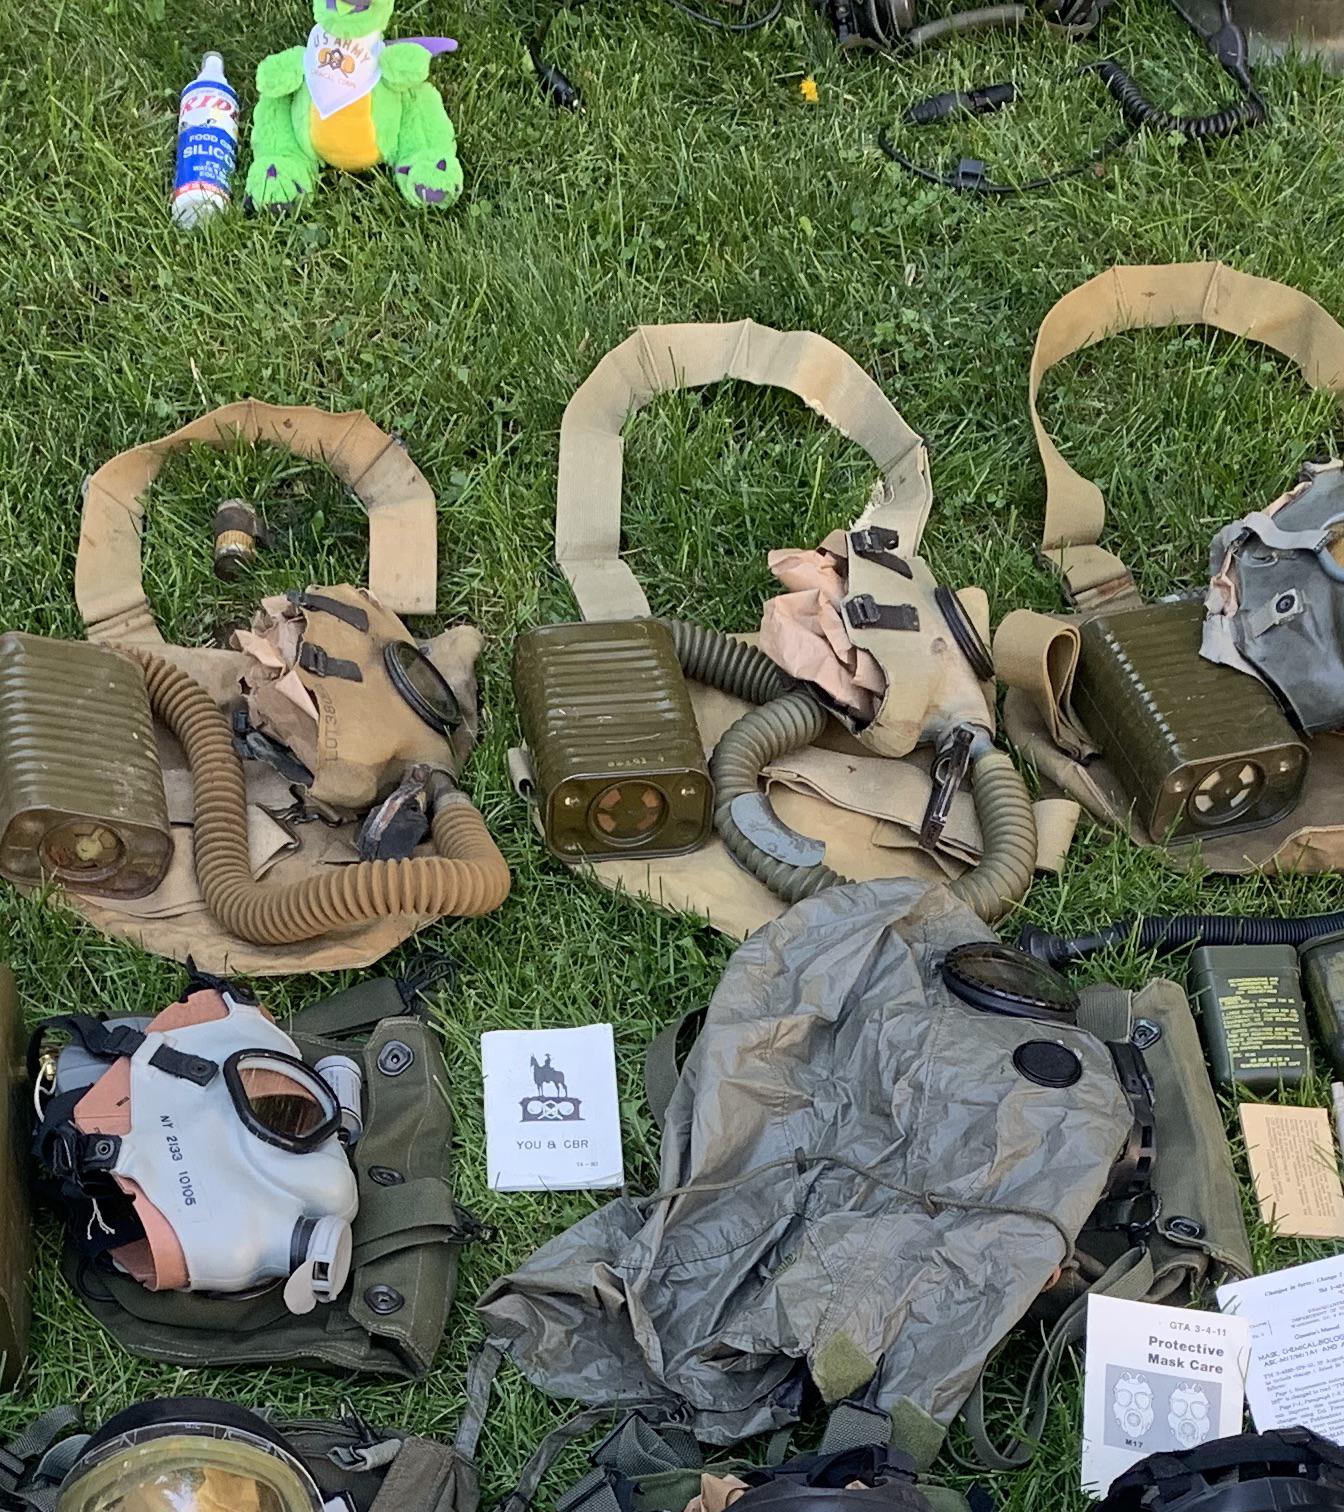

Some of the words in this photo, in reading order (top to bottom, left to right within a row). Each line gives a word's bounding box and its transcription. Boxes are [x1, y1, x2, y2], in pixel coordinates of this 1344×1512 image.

[189, 134, 218, 143] FOOD
[159, 1115, 174, 1129] NY
[166, 1135, 183, 1162] 2133
[516, 1140, 542, 1149] YOU
[563, 1139, 589, 1149] CBR
[178, 1170, 197, 1206] 10105
[1169, 1321, 1191, 1332] GTA
[1194, 1325, 1227, 1337] 3-4-11
[1148, 1335, 1225, 1357] Protective
[1322, 1343, 1338, 1352] AND
[1147, 1353, 1185, 1369] Mask
[1190, 1359, 1224, 1374] Care
[1125, 1438, 1144, 1449] M17
